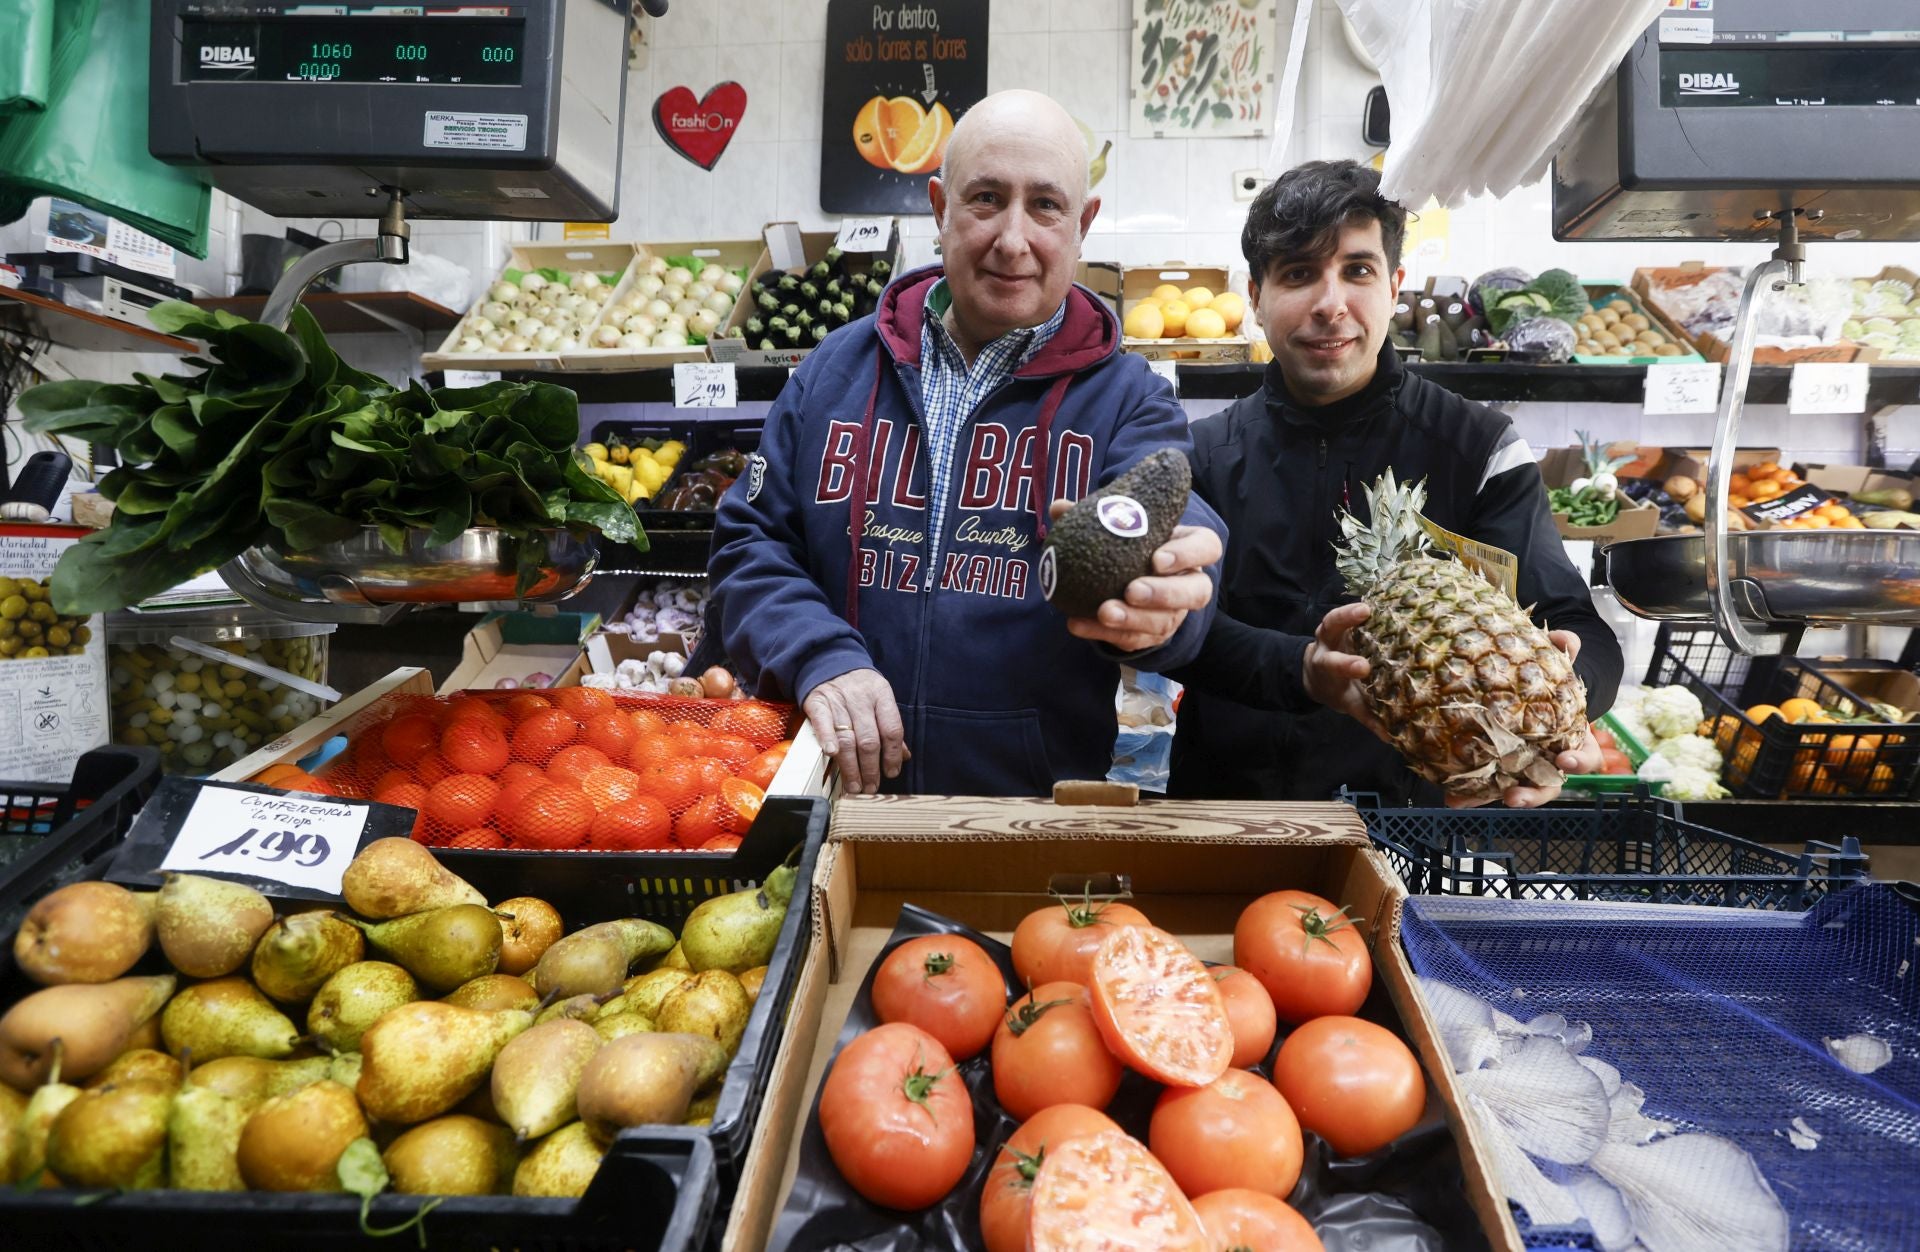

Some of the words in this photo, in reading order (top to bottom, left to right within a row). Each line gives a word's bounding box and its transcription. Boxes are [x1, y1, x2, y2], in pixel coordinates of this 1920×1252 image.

[873, 5, 894, 30] Por
[898, 3, 940, 32] dentro,
[200, 46, 254, 63] DIBAL
[312, 44, 352, 58] 1.060
[396, 45, 427, 60] 0.00
[482, 47, 514, 62] 0.00
[878, 34, 912, 60] Torres
[915, 41, 928, 60] es
[932, 33, 967, 60] Torres
[1679, 73, 1740, 89] DIBAL
[444, 125, 476, 133] SERVICIO
[683, 383, 726, 405] 2.99
[847, 510, 924, 546] Basque
[955, 515, 1030, 552] Country
[198, 828, 331, 867] 1.99
